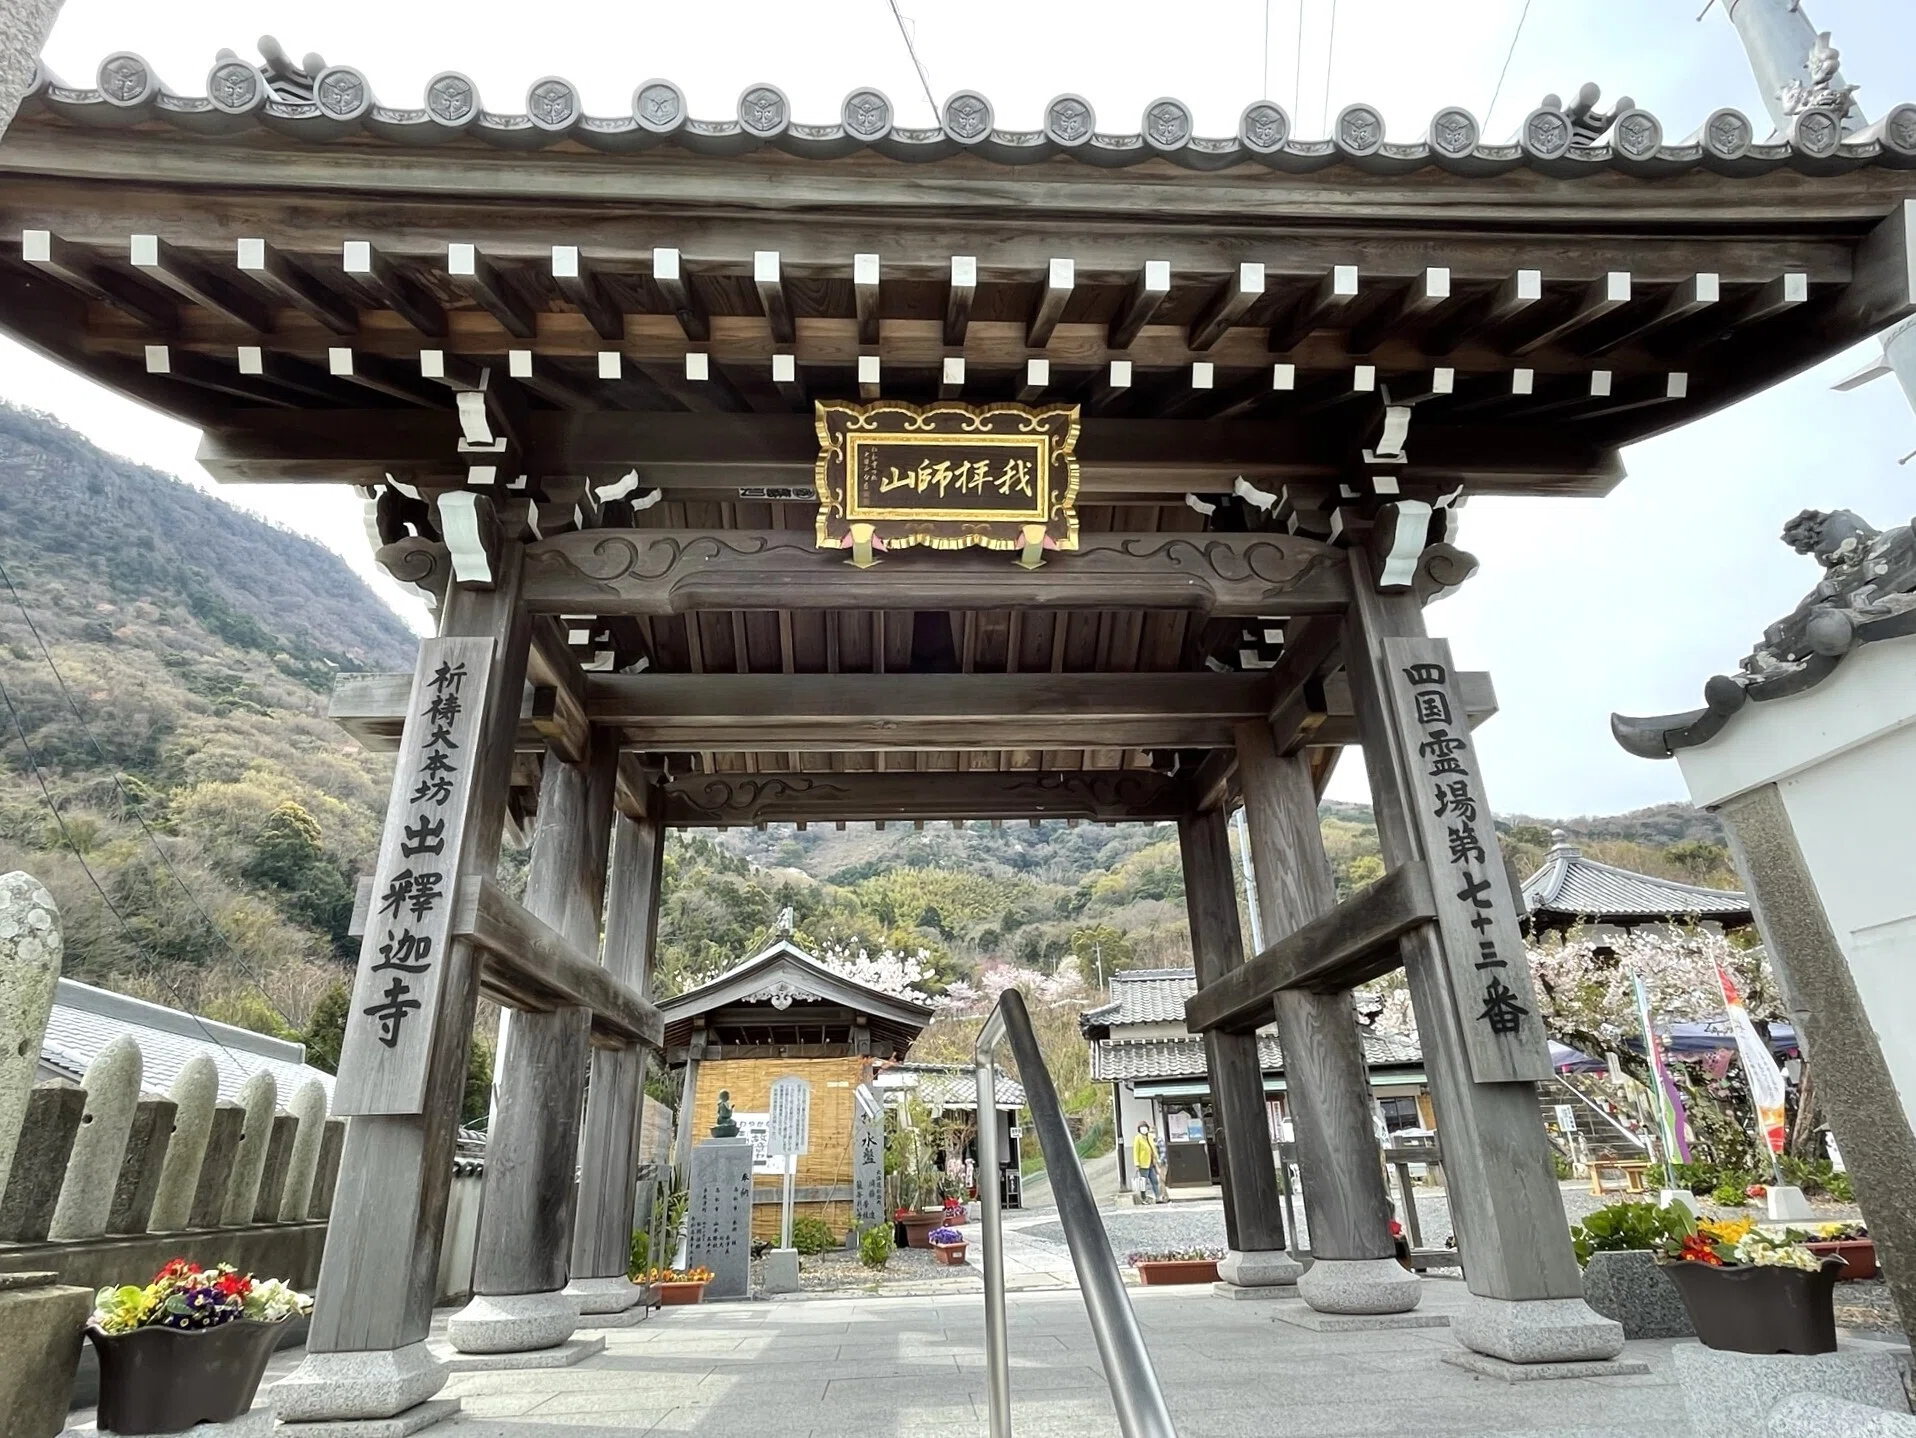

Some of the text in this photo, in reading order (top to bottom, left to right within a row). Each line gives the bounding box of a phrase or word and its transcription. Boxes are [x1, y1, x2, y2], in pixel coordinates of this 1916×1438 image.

[1402, 663, 1529, 1035] 四国霊場第七十三番
